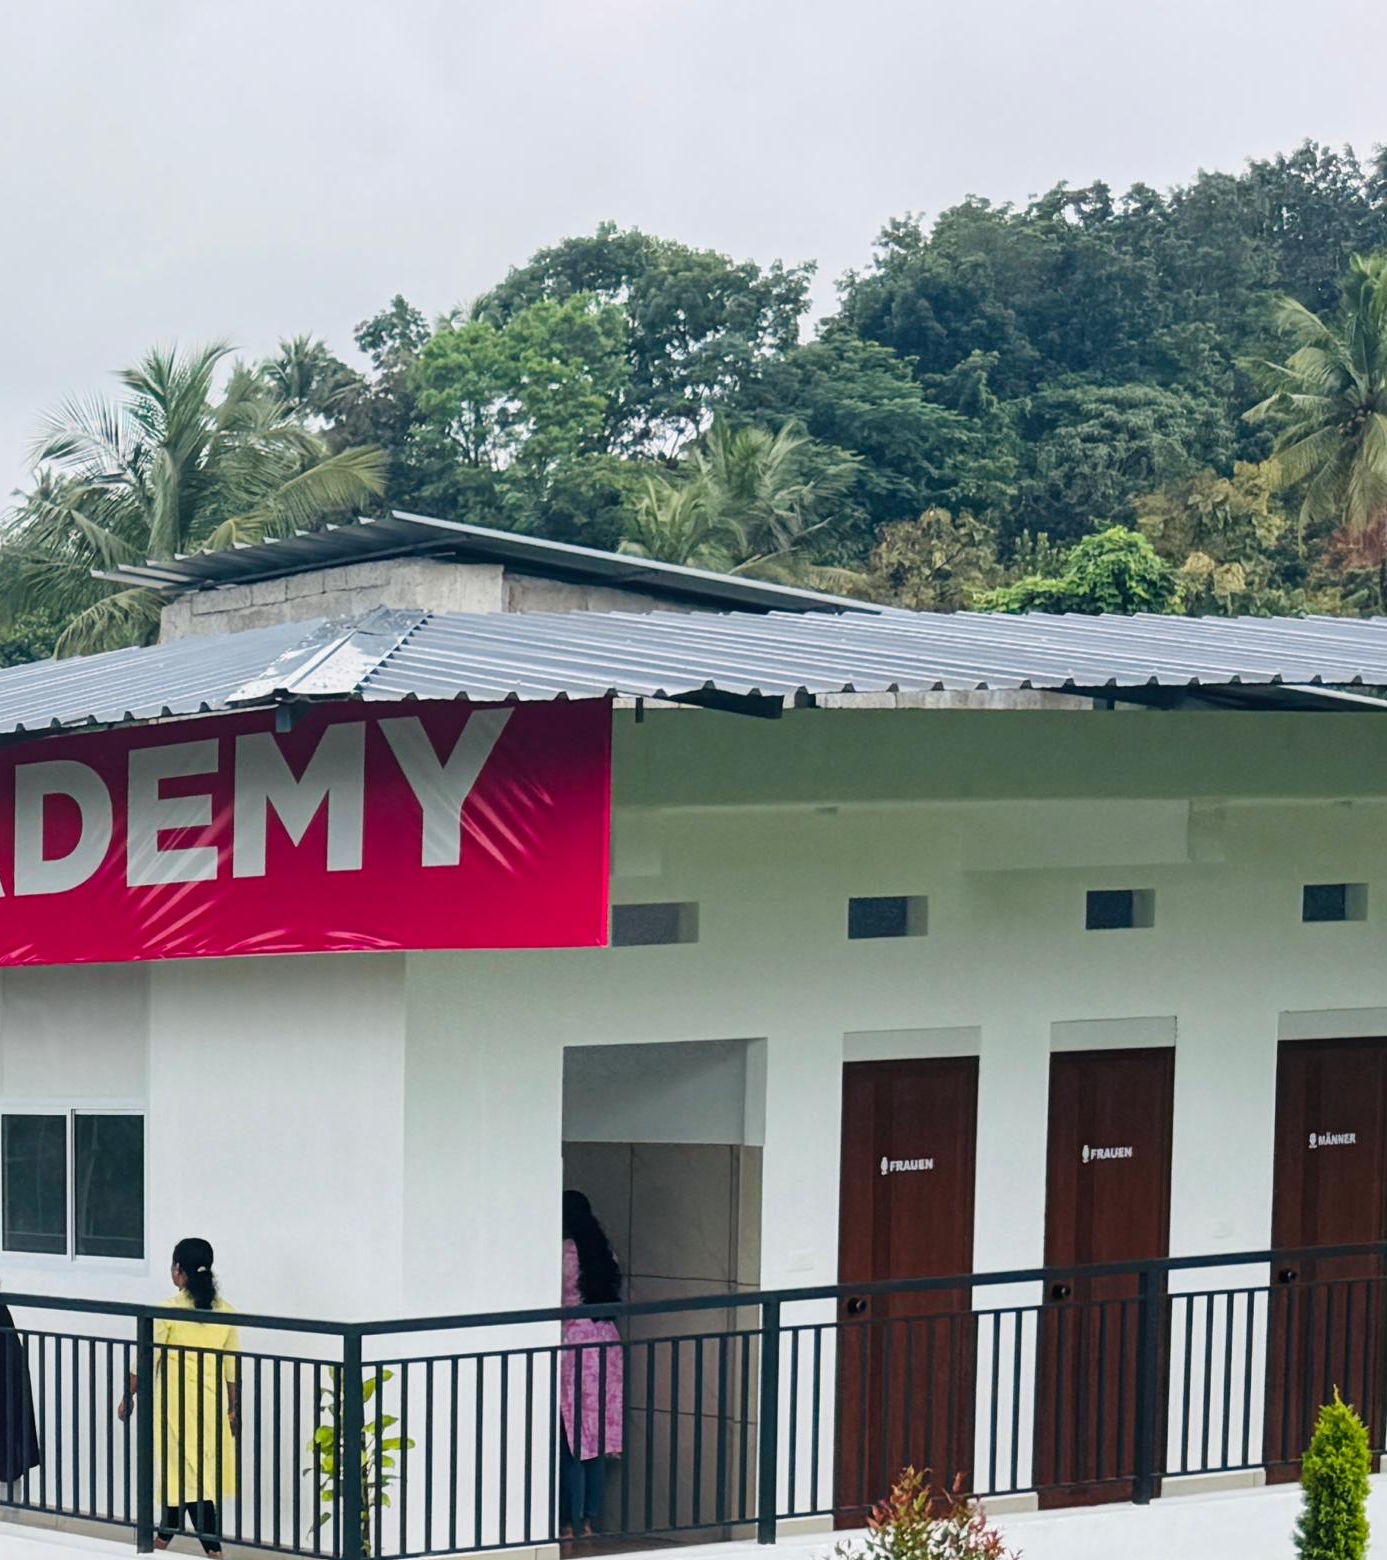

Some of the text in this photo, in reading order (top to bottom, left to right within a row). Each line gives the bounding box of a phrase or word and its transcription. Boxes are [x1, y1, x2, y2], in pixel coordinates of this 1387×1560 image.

[1318, 1131, 1356, 1146] MÄNNER
[1090, 1146, 1133, 1160] FRAUEN
[889, 1158, 934, 1172] FRAUEN
